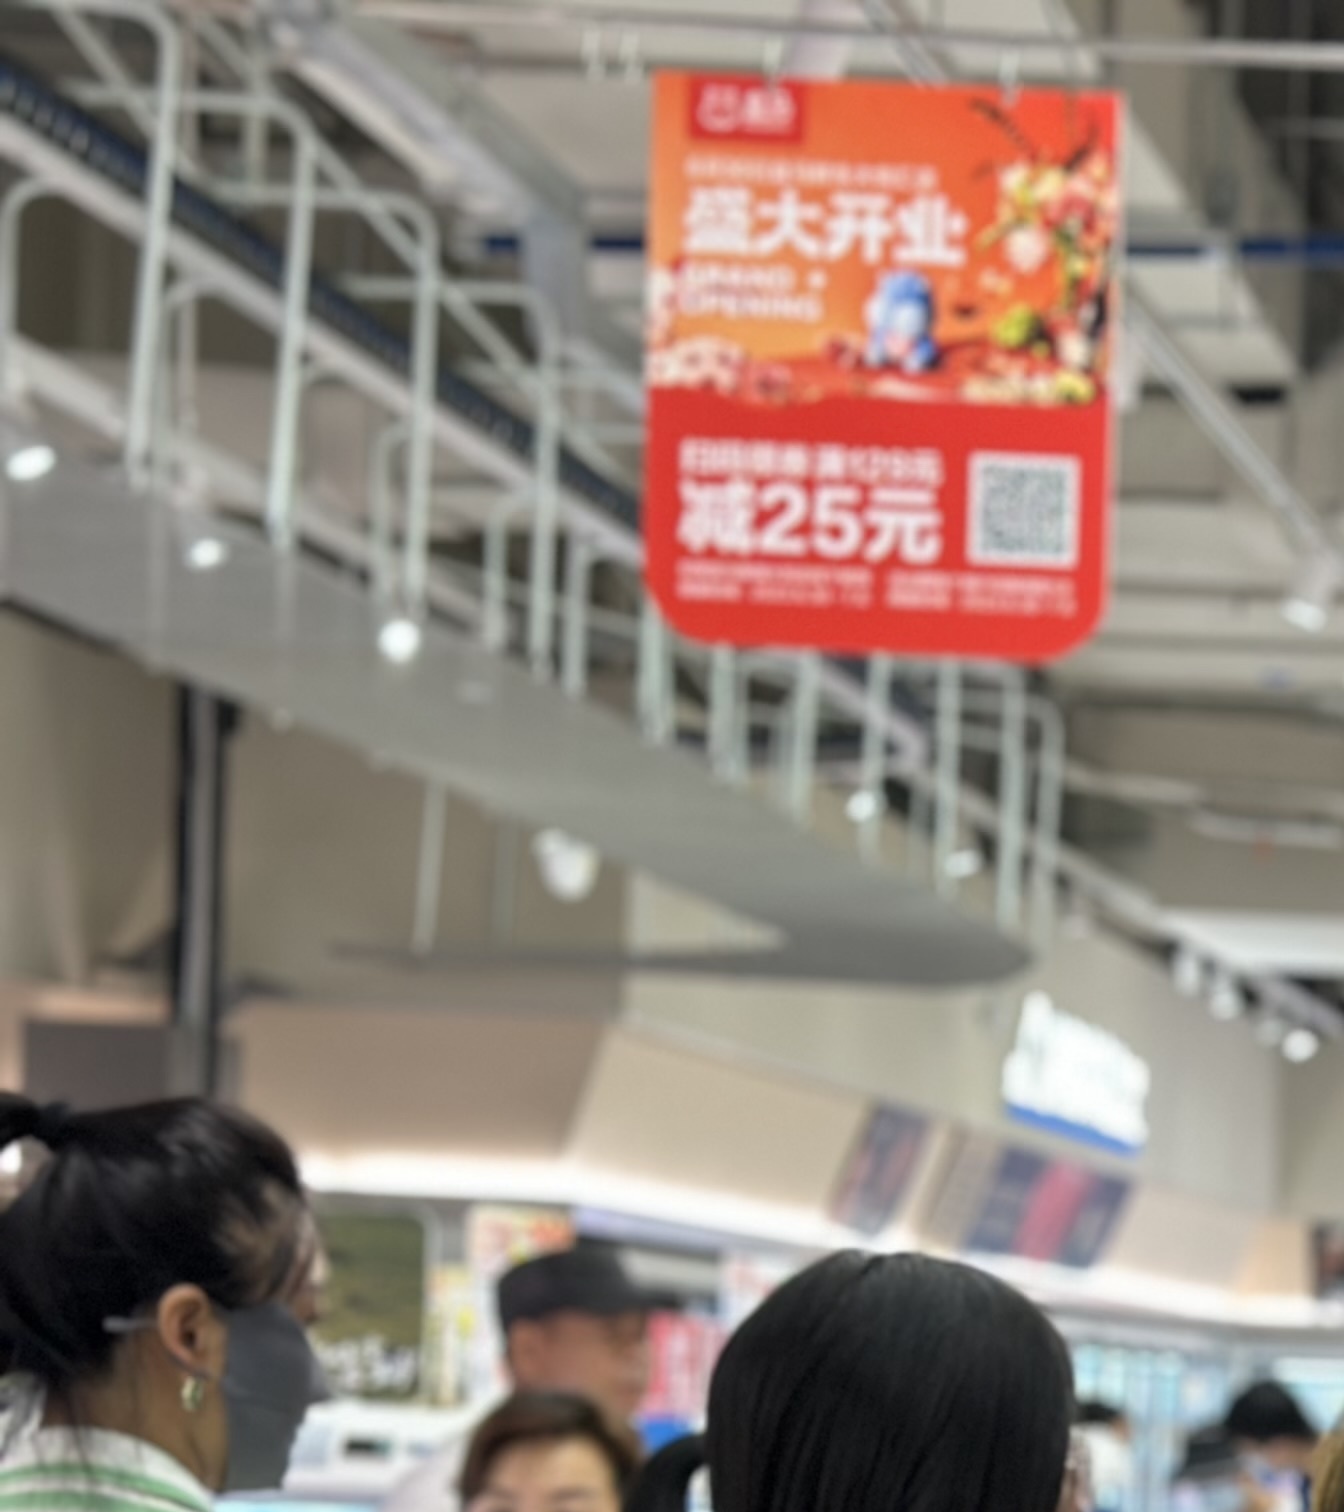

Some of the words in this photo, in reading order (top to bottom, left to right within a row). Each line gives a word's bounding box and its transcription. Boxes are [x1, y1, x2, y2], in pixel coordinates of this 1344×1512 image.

[682, 185, 968, 267] 盛大开业
[677, 477, 943, 565] 减25元
